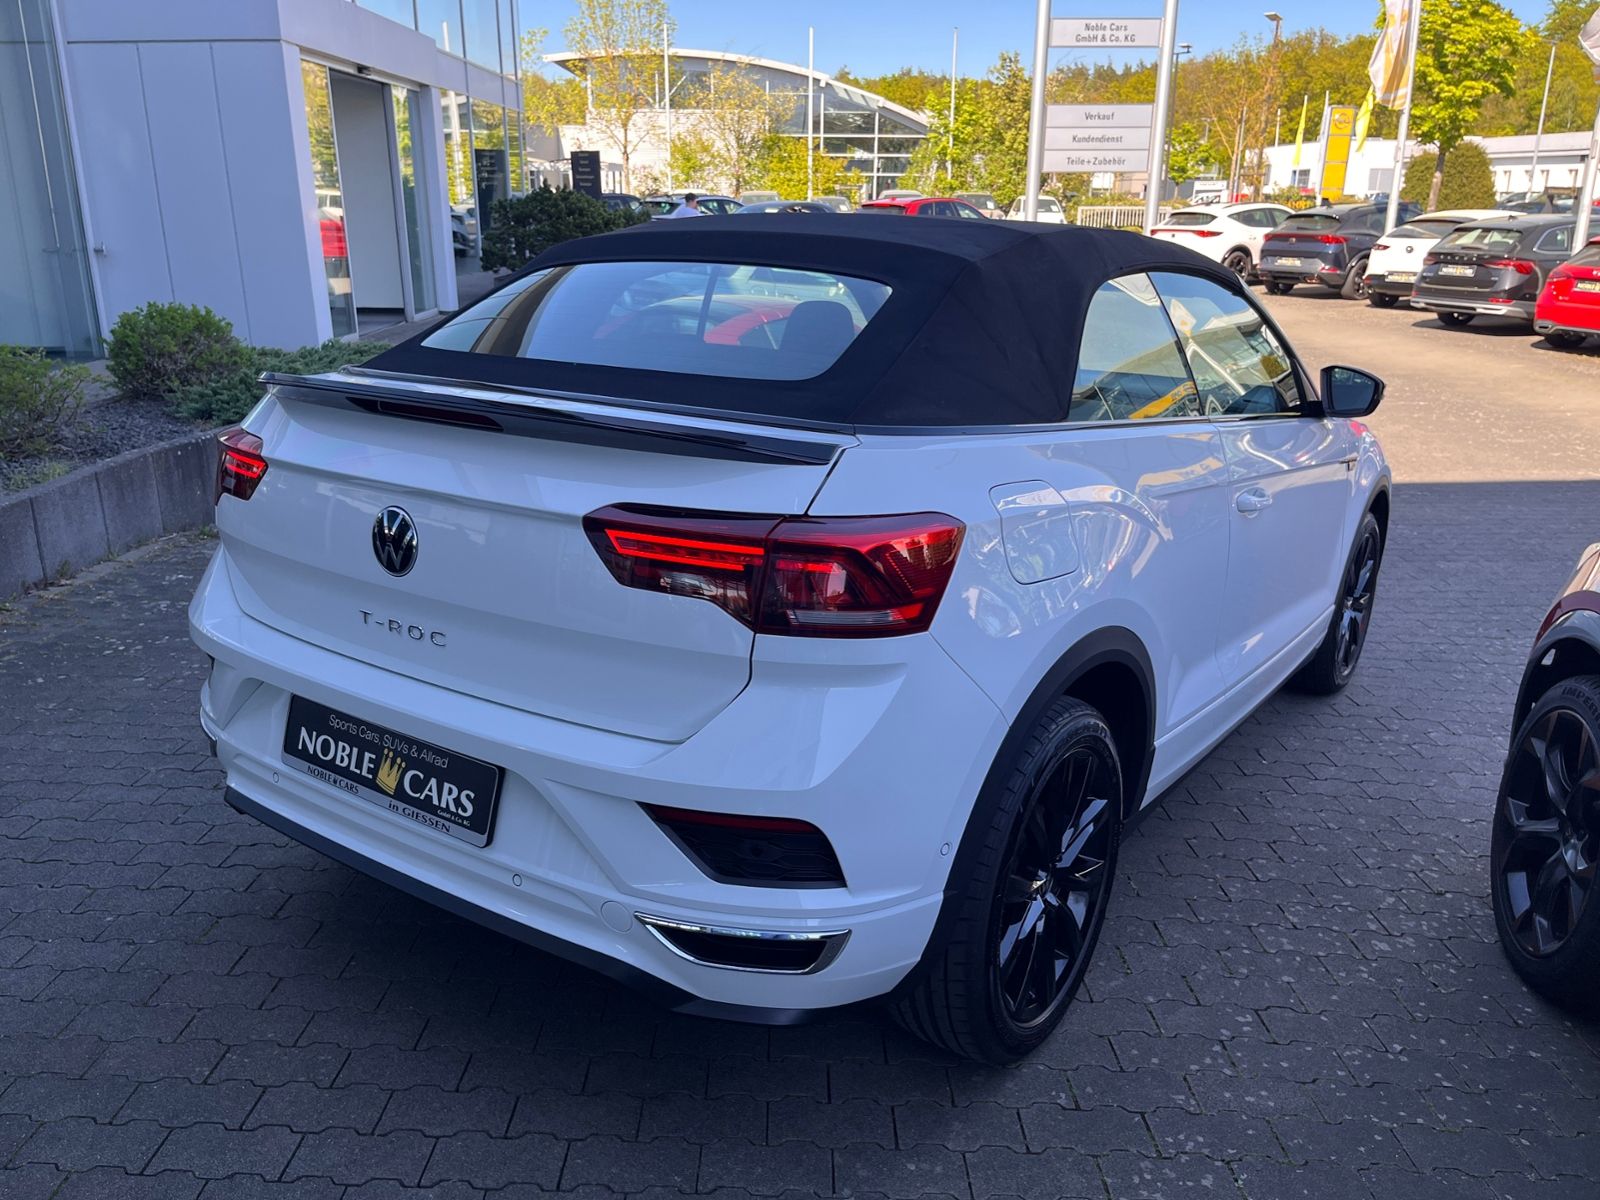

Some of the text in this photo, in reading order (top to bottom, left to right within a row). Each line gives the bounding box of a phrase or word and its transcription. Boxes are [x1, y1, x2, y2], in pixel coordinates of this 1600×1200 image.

[1075, 34, 1136, 42] GmbH & Co. KG
[1084, 23, 1128, 32] Noble Cars
[1085, 112, 1115, 120] Verkauf
[1072, 134, 1123, 143] Kundendienst
[360, 609, 447, 647] T-ROC
[329, 714, 449, 768] Sports Cars, SUVs & Allrad
[298, 726, 476, 817] NOBLE CARS
[307, 765, 359, 793] NOBLE CARS
[388, 800, 451, 833] in GIESSEN
